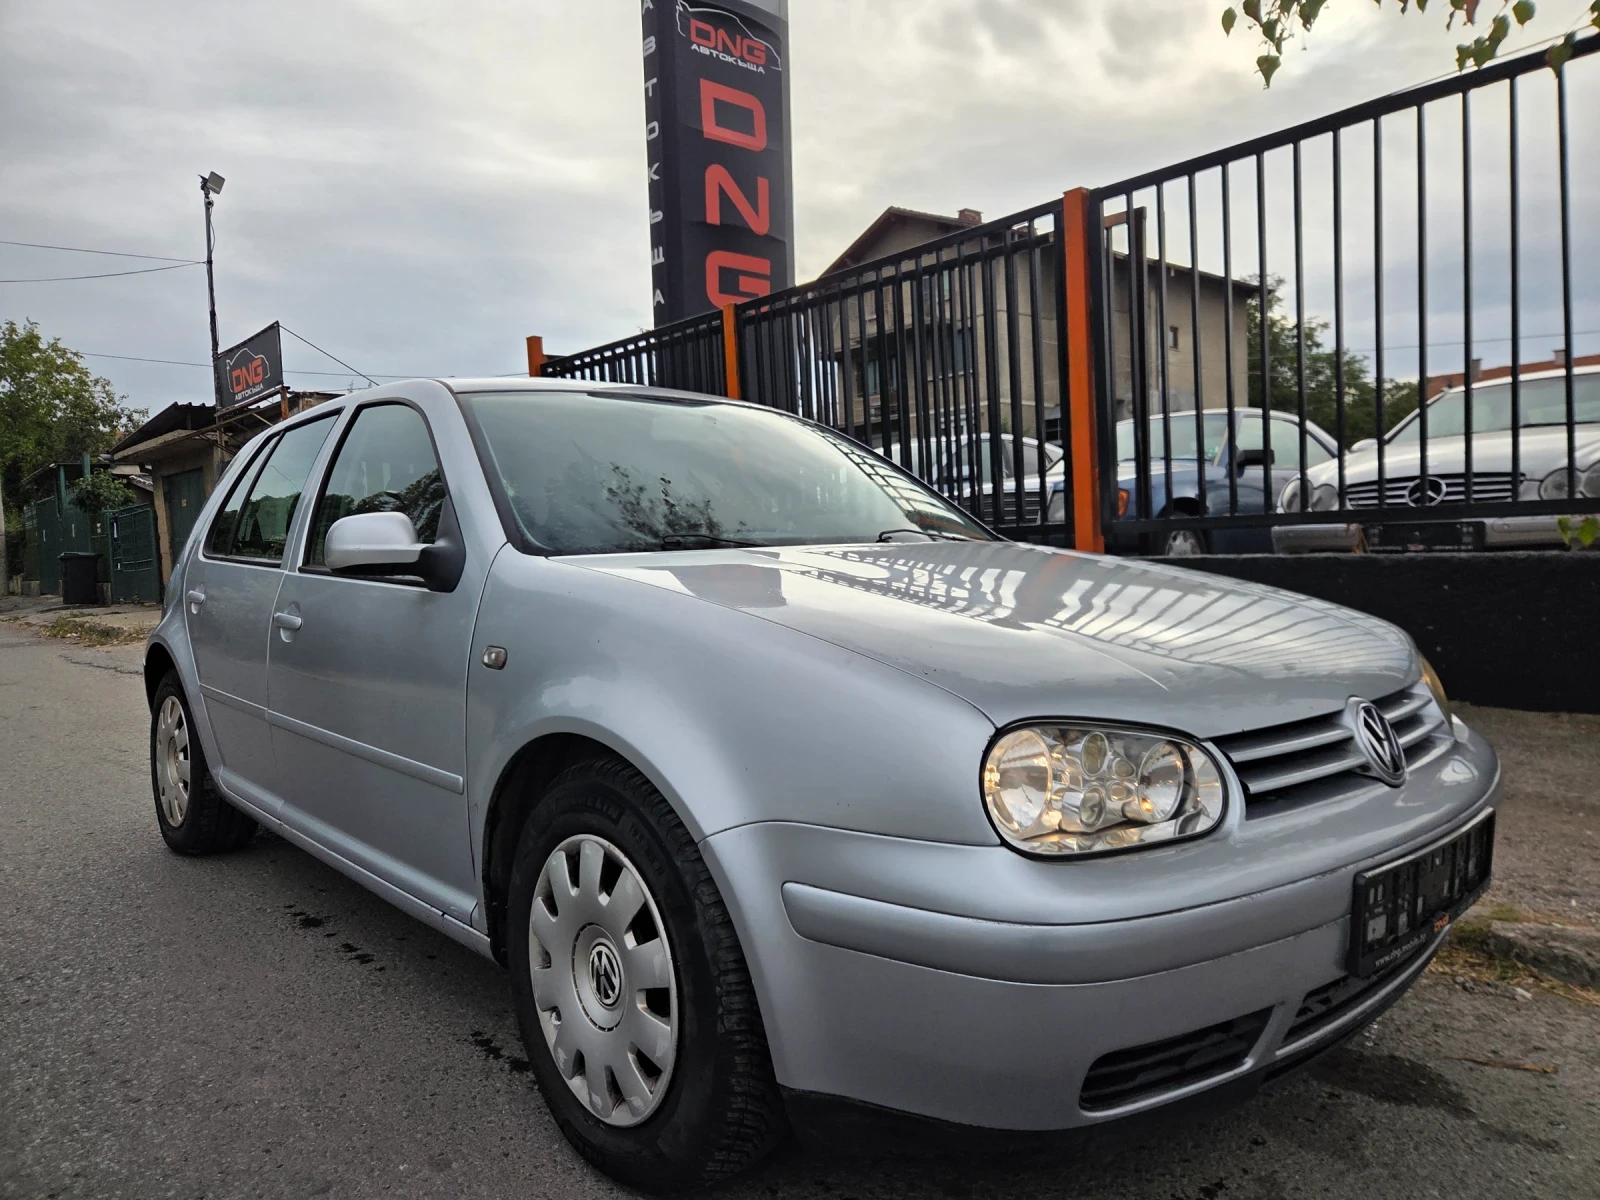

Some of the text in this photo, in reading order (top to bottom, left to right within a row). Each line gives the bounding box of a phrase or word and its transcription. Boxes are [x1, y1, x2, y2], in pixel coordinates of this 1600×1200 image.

[690, 18, 766, 65] DNG
[691, 43, 765, 74] АВТОКЪША
[699, 77, 771, 312] DNG
[232, 357, 263, 393] DNG
